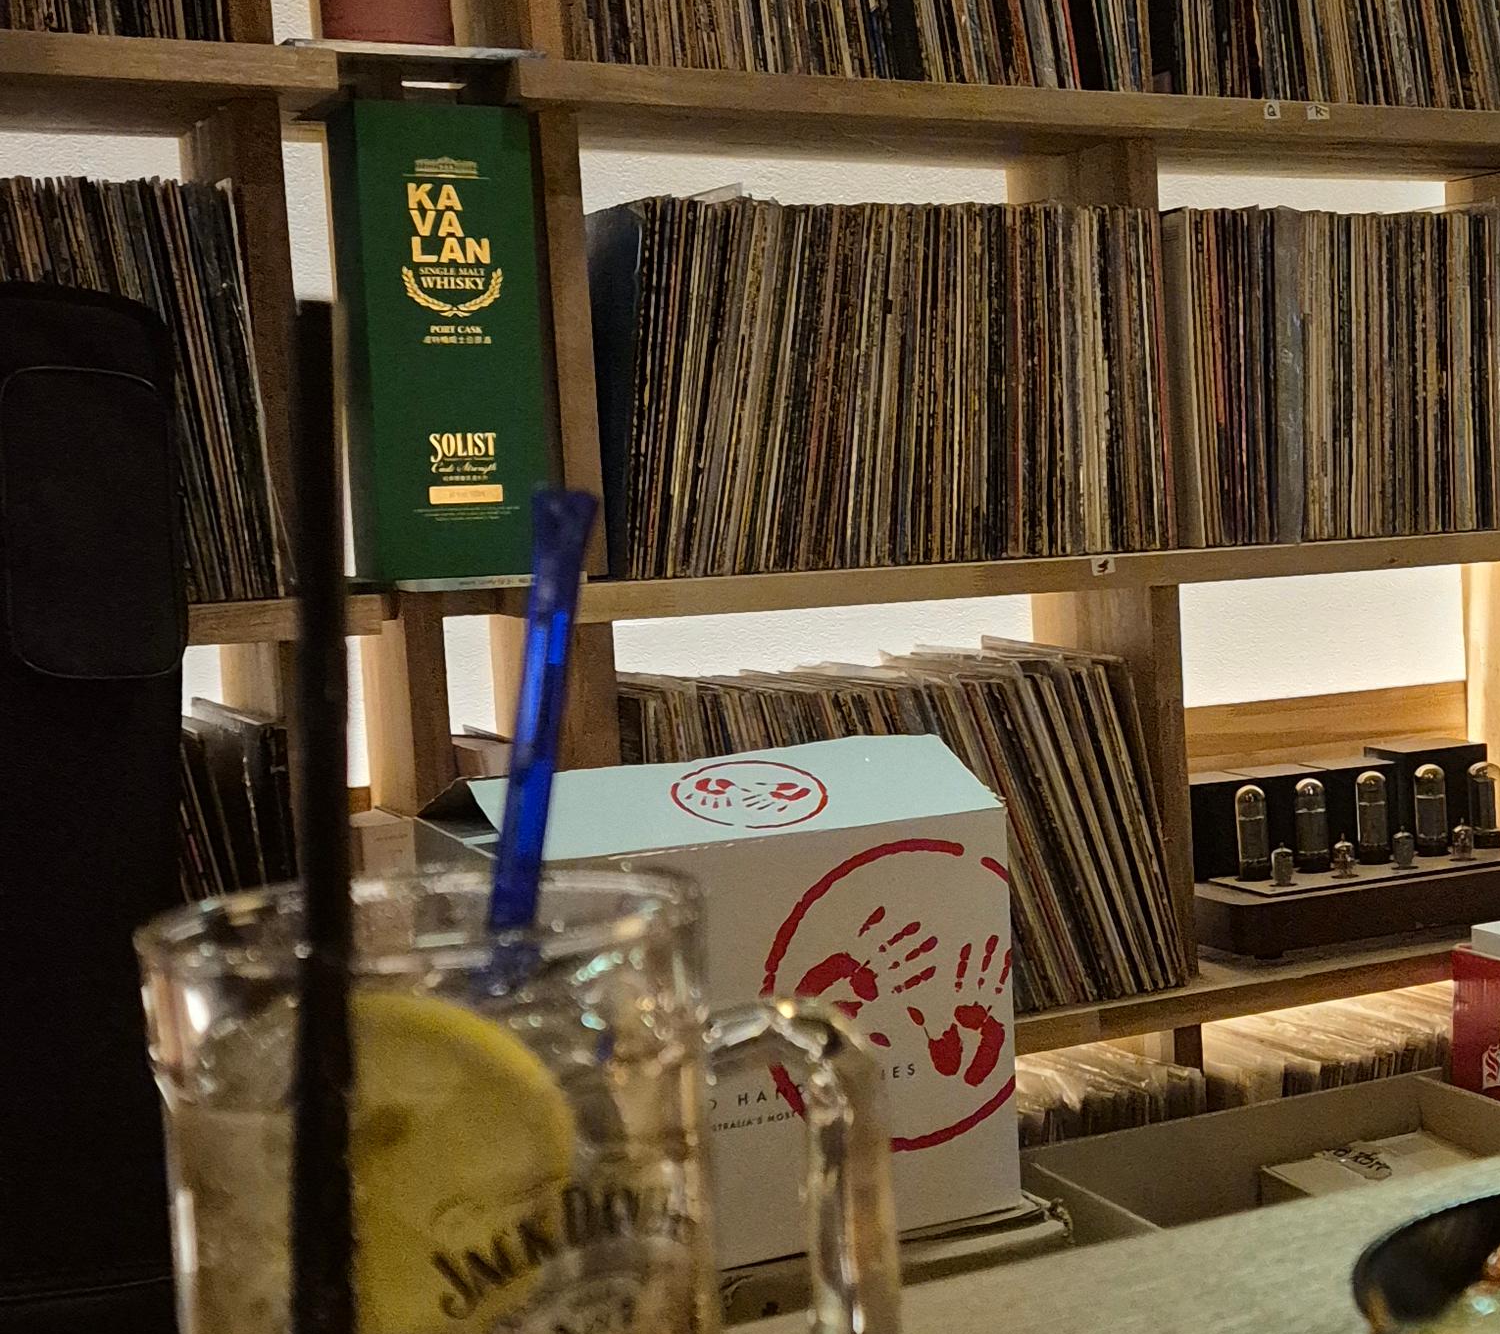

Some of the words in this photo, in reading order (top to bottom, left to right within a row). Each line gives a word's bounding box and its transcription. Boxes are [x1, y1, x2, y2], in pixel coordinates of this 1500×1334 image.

[418, 266, 456, 276] SINGLE
[458, 267, 486, 276] MALT
[420, 276, 486, 290] WHISKY
[429, 325, 455, 334] PORT
[457, 325, 483, 334] CASK
[428, 431, 497, 463] SOLIST
